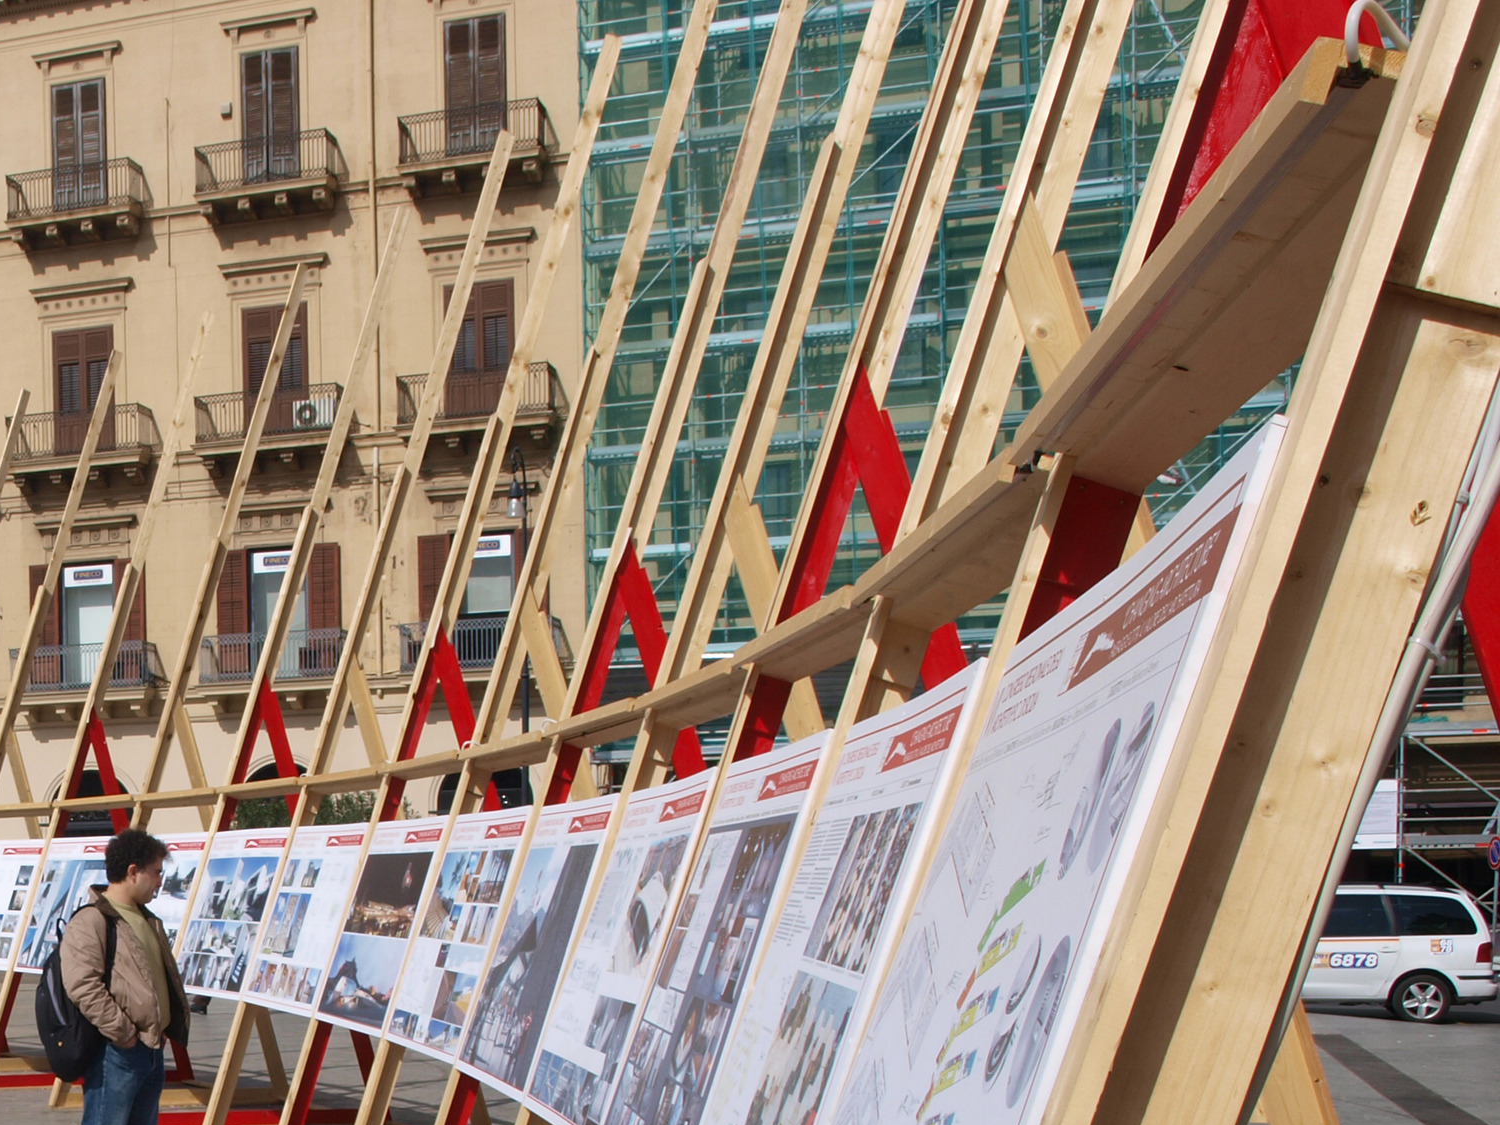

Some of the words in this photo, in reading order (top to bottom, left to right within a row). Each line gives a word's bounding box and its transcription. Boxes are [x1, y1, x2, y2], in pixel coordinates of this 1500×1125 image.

[265, 556, 290, 565] FINEC
[75, 571, 101, 579] FINECO
[1330, 953, 1378, 968] 6878
